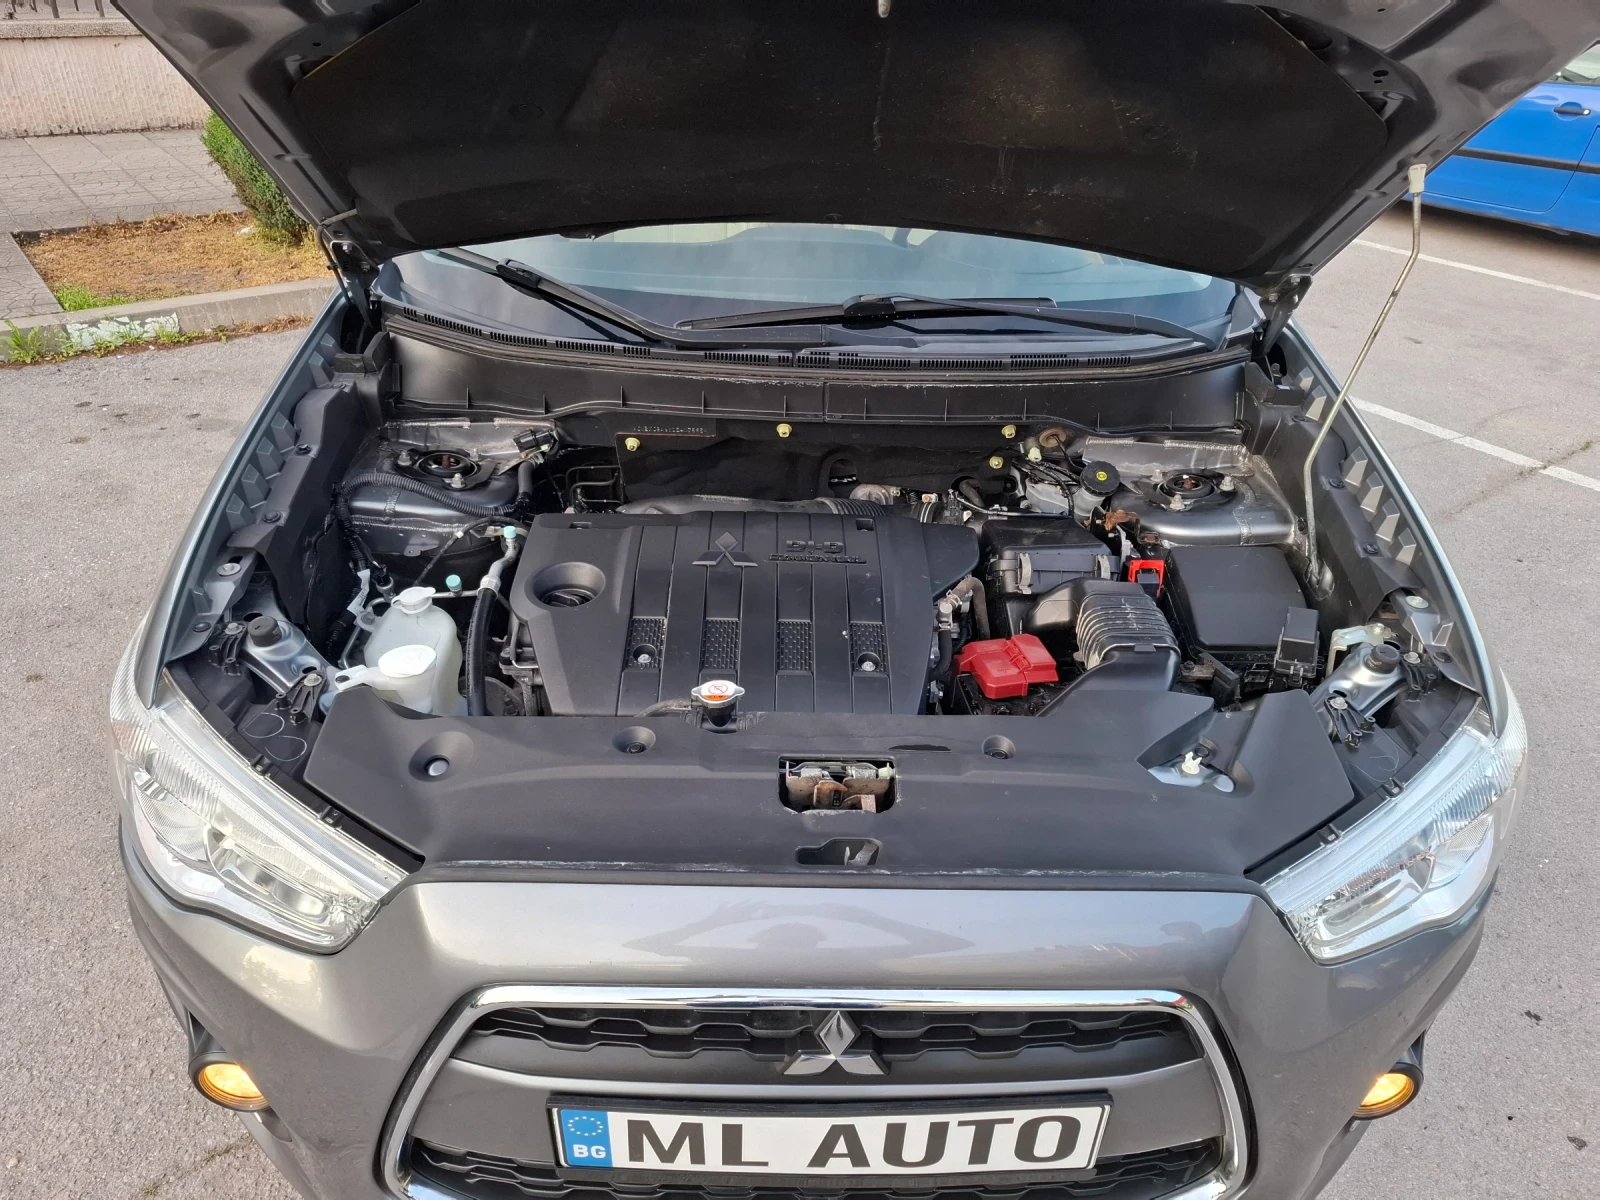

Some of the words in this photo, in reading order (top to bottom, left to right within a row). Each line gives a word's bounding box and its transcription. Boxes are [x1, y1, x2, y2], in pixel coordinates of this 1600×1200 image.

[573, 1144, 606, 1159] BG
[627, 1119, 769, 1166] ML
[806, 1115, 1082, 1168] AUTO
